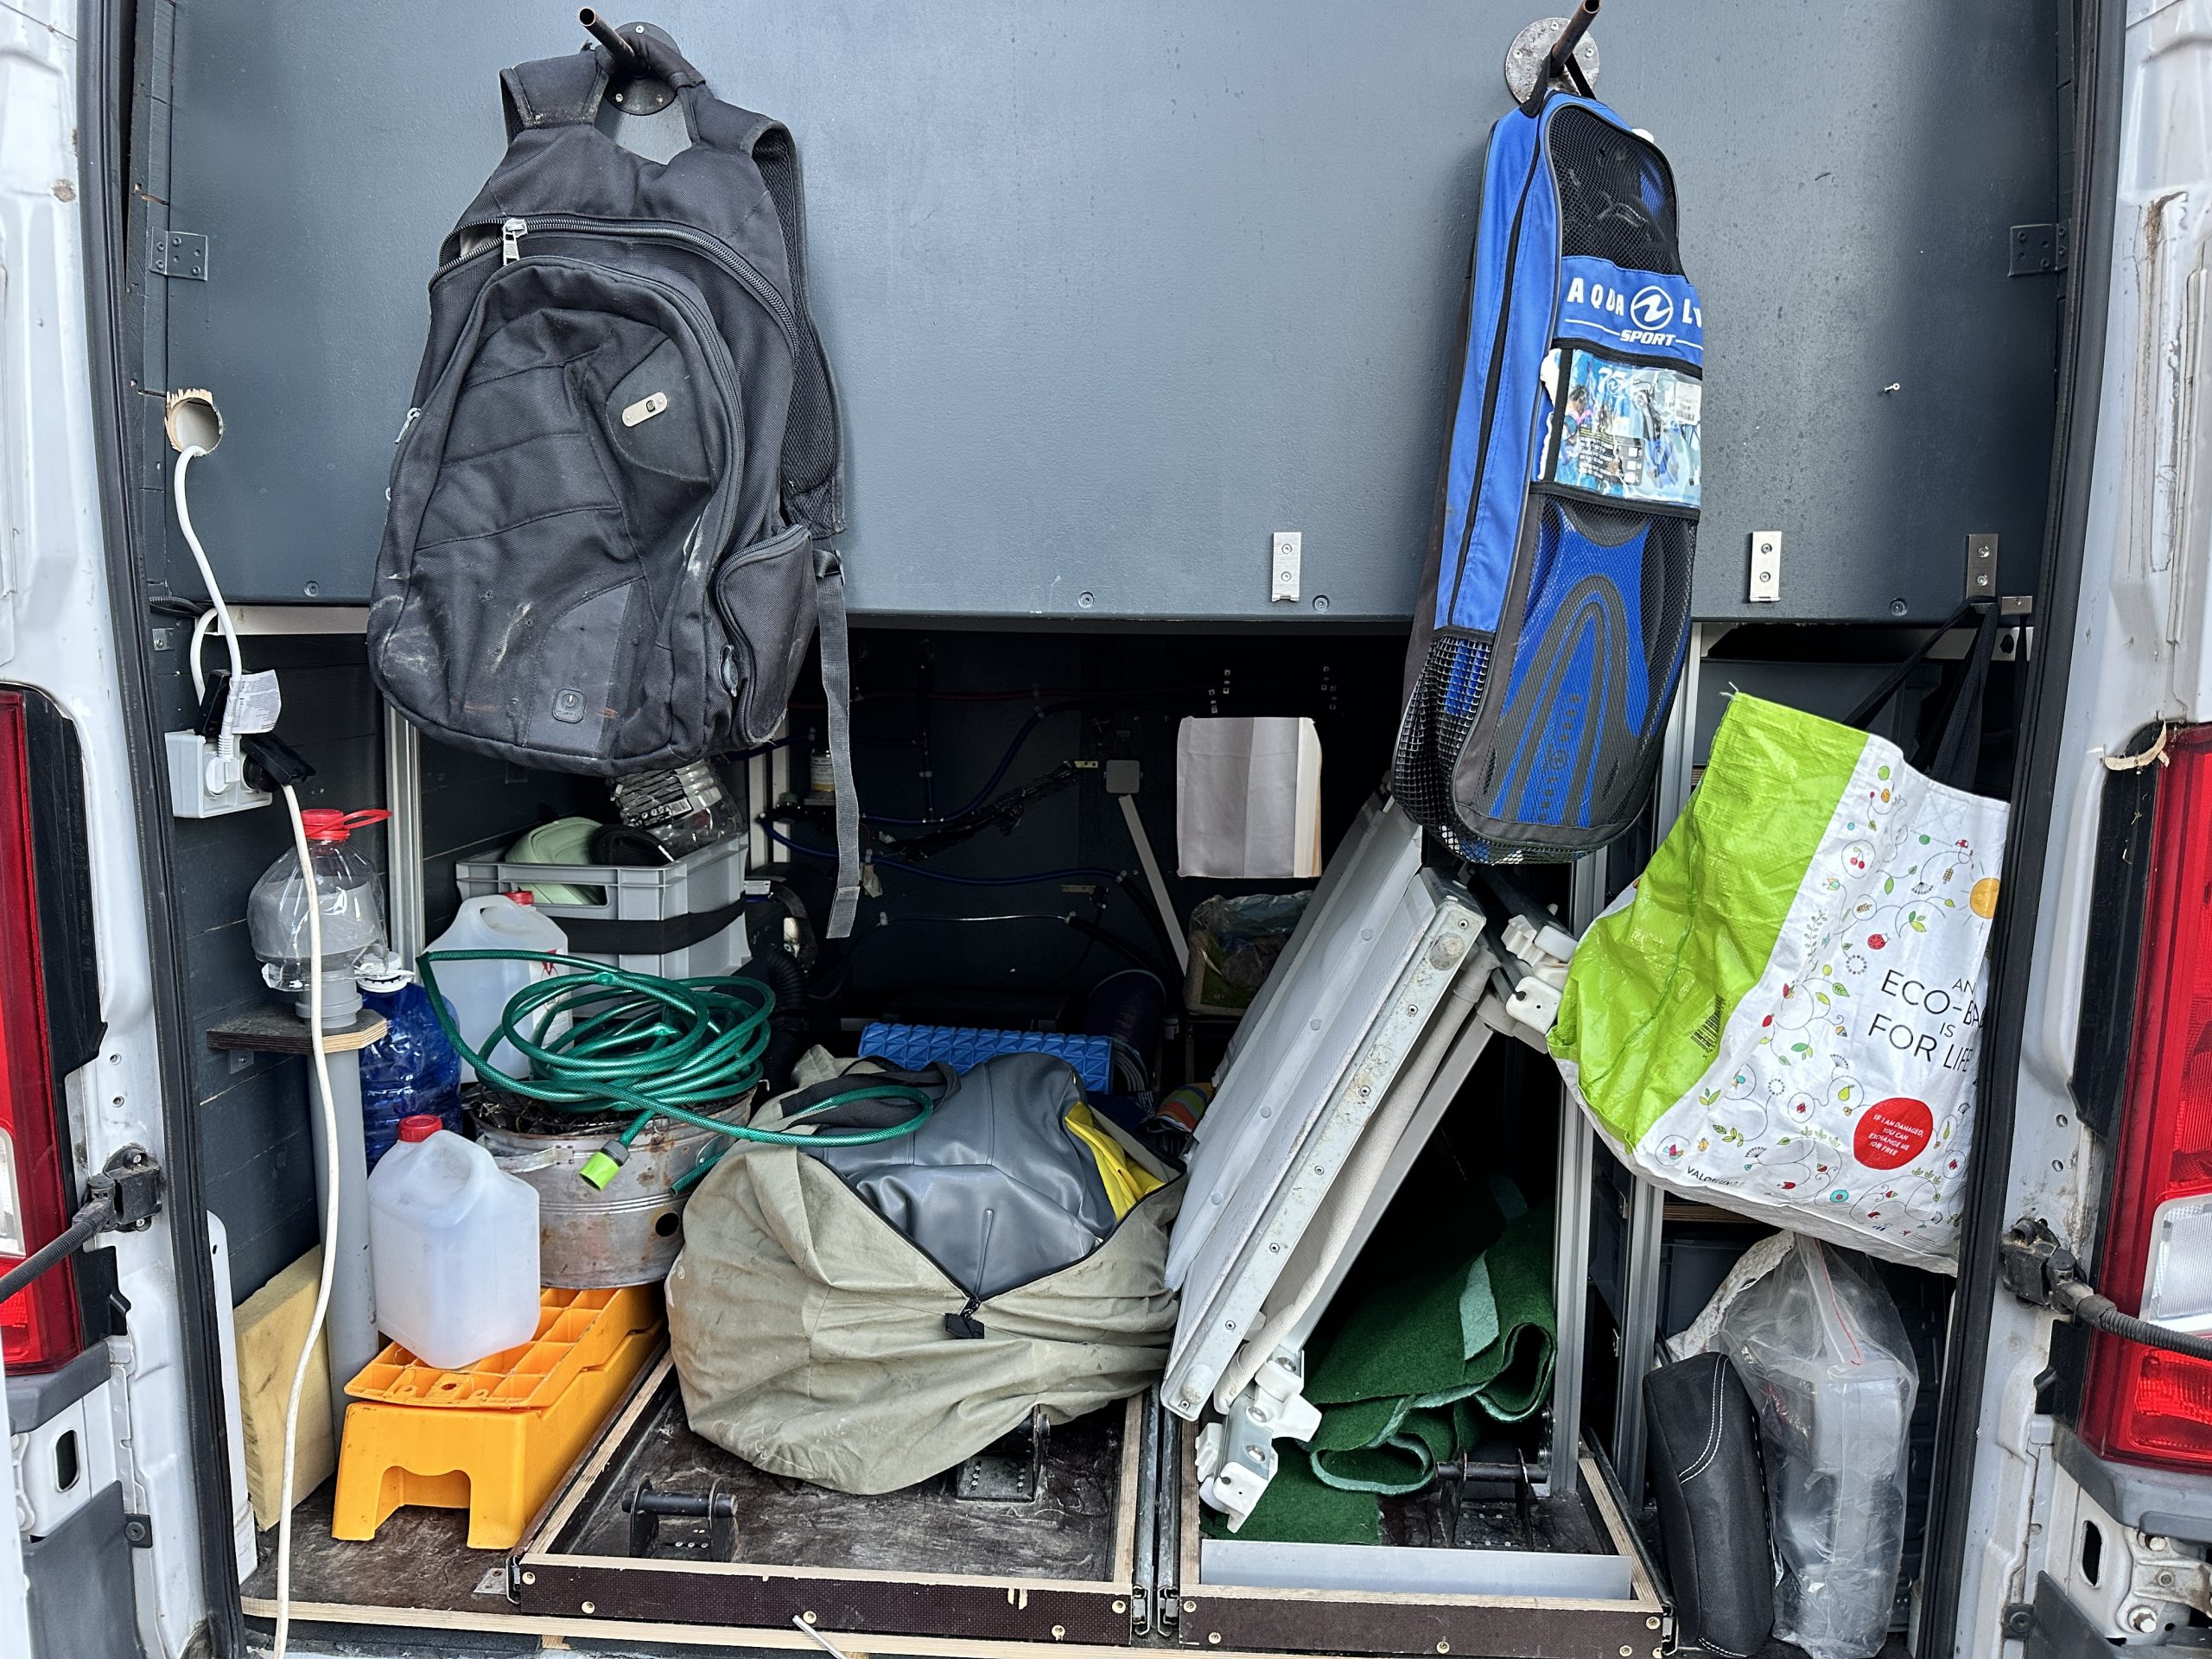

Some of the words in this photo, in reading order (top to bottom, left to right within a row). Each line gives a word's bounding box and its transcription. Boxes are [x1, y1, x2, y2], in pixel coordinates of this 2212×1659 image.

[1567, 277, 1624, 316] AQUA
[1619, 329, 1676, 346] SPORT
[1951, 978, 1976, 995] AN
[1939, 1022, 1955, 1038] IS
[1867, 1013, 1938, 1063] FOR
[1942, 1044, 1974, 1072] LIFE
[1883, 1128, 1896, 1136] YOU
[1895, 1132, 1910, 1141] CAN
[1894, 1122, 1924, 1138] DAMAGED,
[1881, 1146, 1898, 1156] FREE
